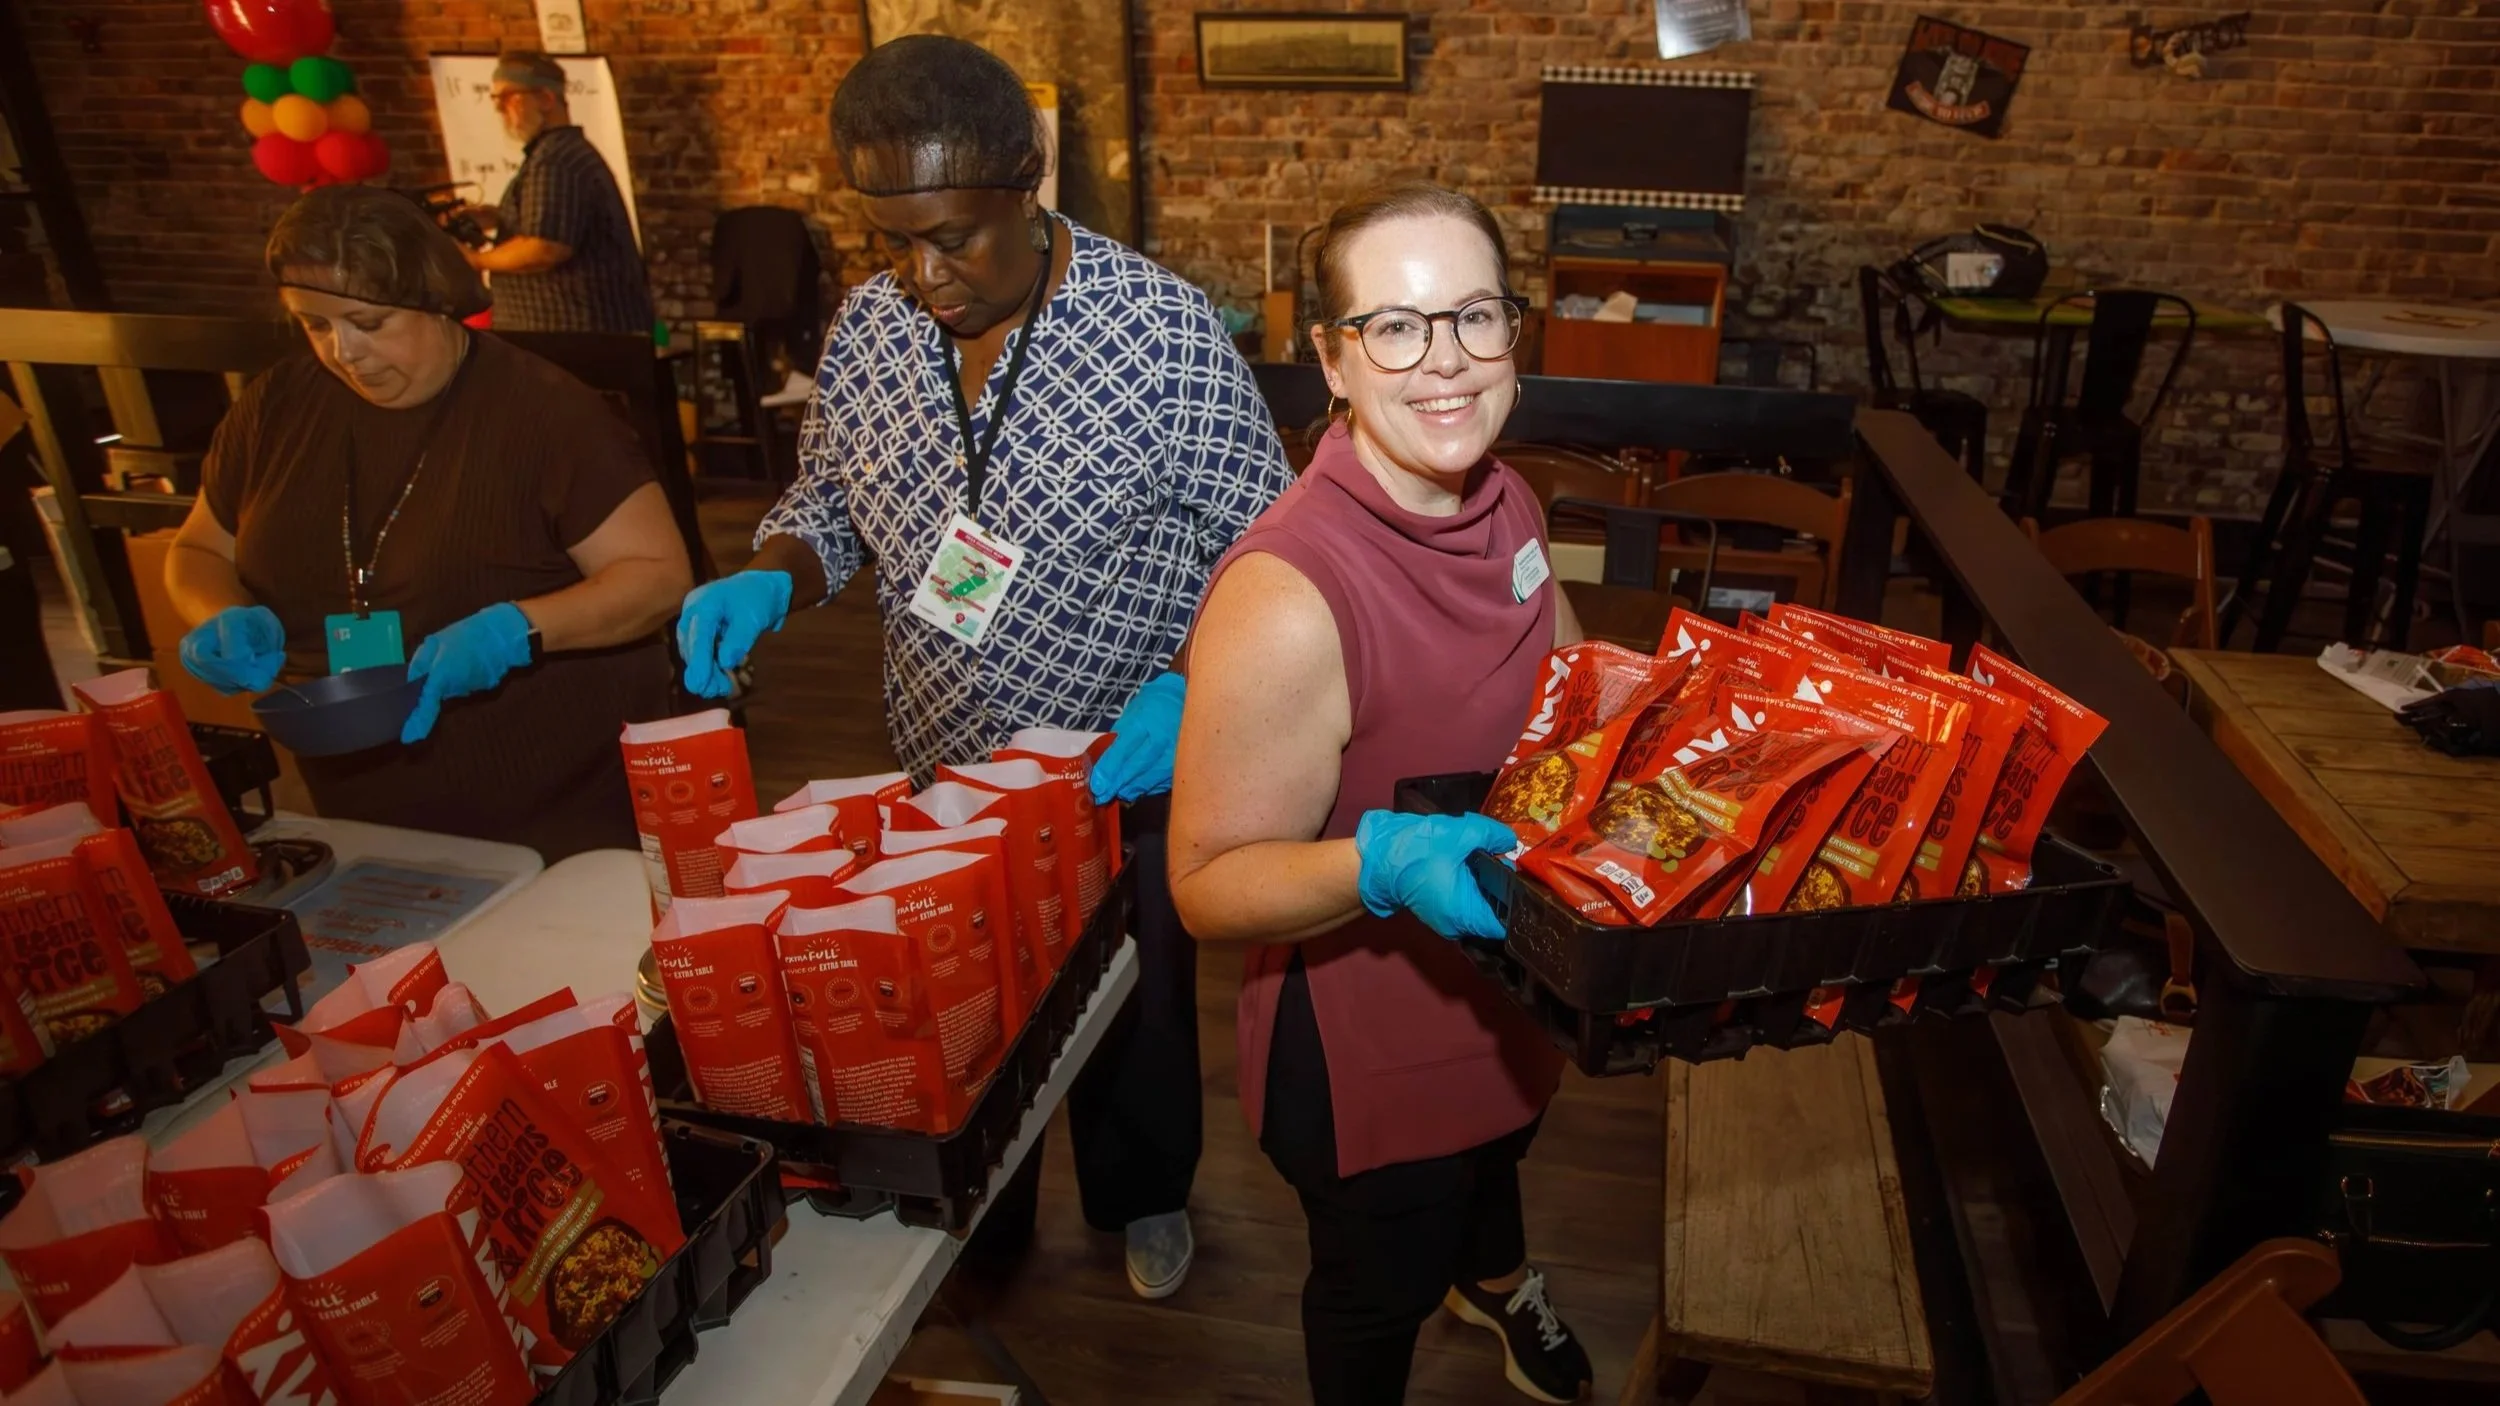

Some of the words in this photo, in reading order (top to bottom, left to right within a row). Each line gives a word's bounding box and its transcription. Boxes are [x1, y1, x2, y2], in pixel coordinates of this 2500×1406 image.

[1684, 616, 1729, 638] MISSISSIPPI'S
[1777, 647, 1793, 660] MEAL
[1765, 627, 1793, 643] ORIGINAL
[1793, 638, 1821, 655] ONE-POT
[1822, 650, 1840, 664] MEAL
[1600, 644, 1634, 659] ORIGINAL
[1856, 674, 1890, 690] ORIGINAL
[1891, 684, 1929, 702] ONE-POT
[1957, 681, 1987, 699] ONE-POT
[1987, 692, 2006, 706] MEAL
[2011, 671, 2037, 691] ORIGINAL
[2037, 684, 2066, 707] ONE-POT
[2065, 702, 2085, 720] MEAL
[1734, 692, 1784, 708] MISSISSIPPI'S
[1785, 702, 1818, 715] ORIGINAL
[1819, 708, 1852, 724] ONE-POT
[1854, 719, 1875, 733] MEAL
[648, 755, 674, 767] FULL
[1825, 851, 1861, 873] MINUTES
[910, 895, 936, 912] FULL
[920, 908, 938, 922] EXTRA
[937, 902, 954, 916] TABLE
[662, 956, 693, 970] FULL
[808, 948, 839, 962] FULL
[819, 960, 840, 972] EXTRA
[840, 959, 858, 969] TABLE
[673, 967, 694, 980] EXTRA
[694, 964, 714, 978] TABLE
[396, 1129, 439, 1170] ORIGINAL
[436, 1087, 467, 1128] ONE-POT
[466, 1064, 485, 1088] MEAL
[567, 1200, 598, 1240] MINUTES
[349, 1290, 380, 1313] TABLE
